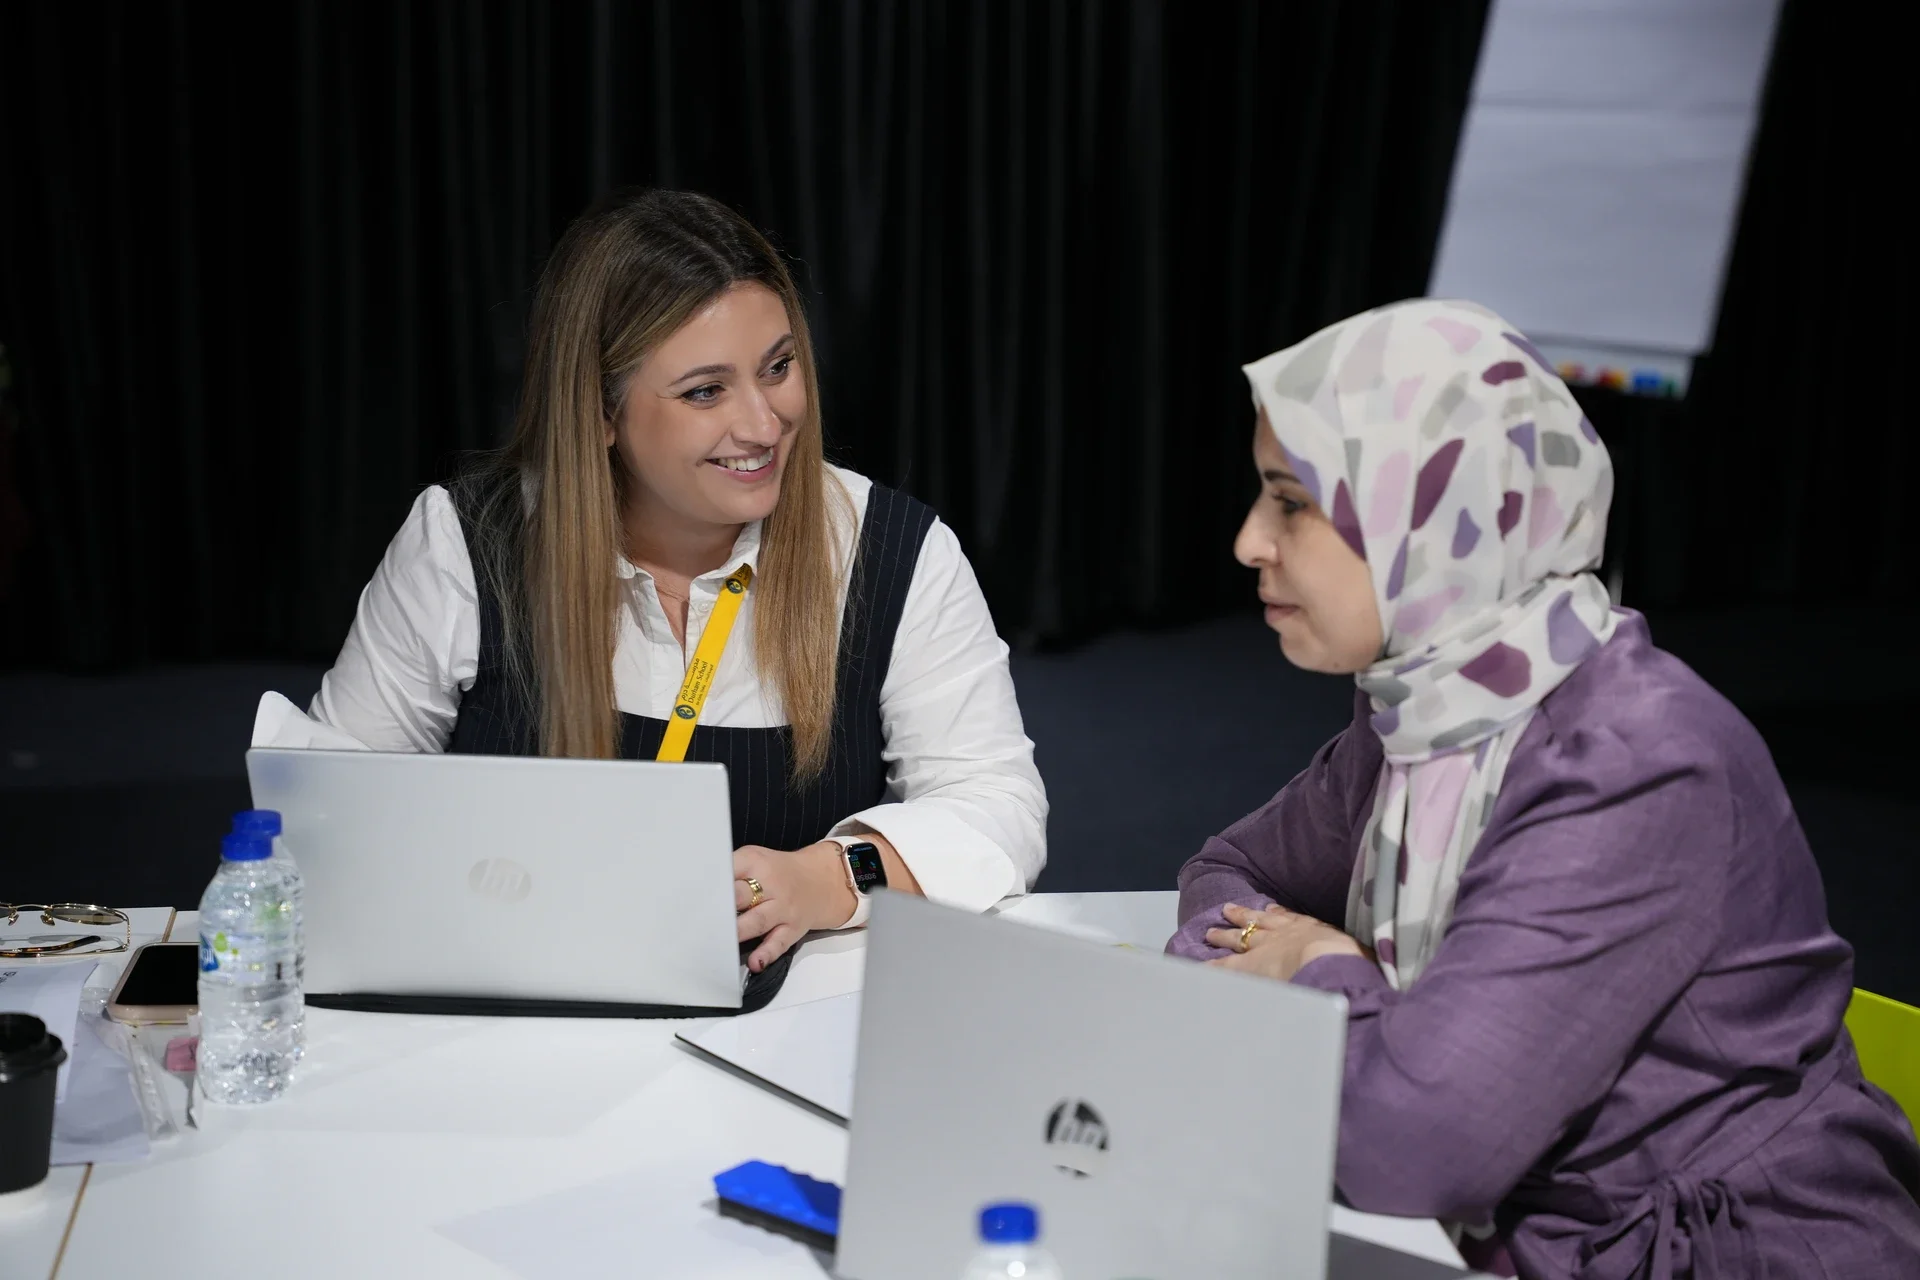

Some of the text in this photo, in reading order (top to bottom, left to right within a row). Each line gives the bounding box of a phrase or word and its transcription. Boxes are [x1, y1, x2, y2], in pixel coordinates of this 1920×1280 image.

[688, 681, 700, 703] Durham
[696, 661, 708, 681] School
[473, 857, 529, 903] hp
